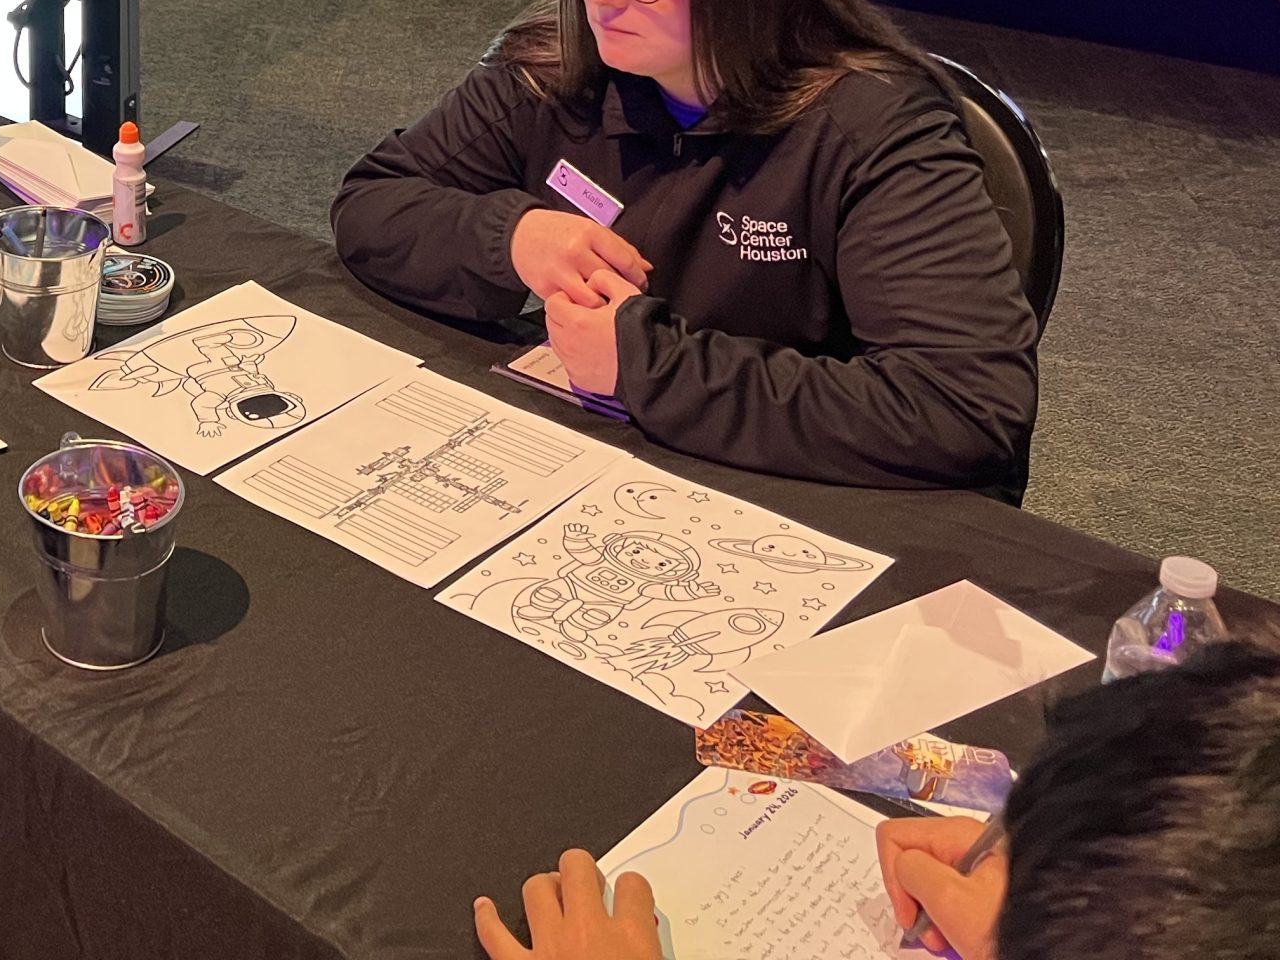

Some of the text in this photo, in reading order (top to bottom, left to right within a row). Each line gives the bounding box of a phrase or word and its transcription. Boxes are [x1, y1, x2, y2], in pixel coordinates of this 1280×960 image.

[741, 215, 788, 234] Space
[740, 230, 793, 247] Center
[740, 245, 807, 261] Houston
[738, 813, 772, 840] January
[776, 787, 799, 804] 2026
